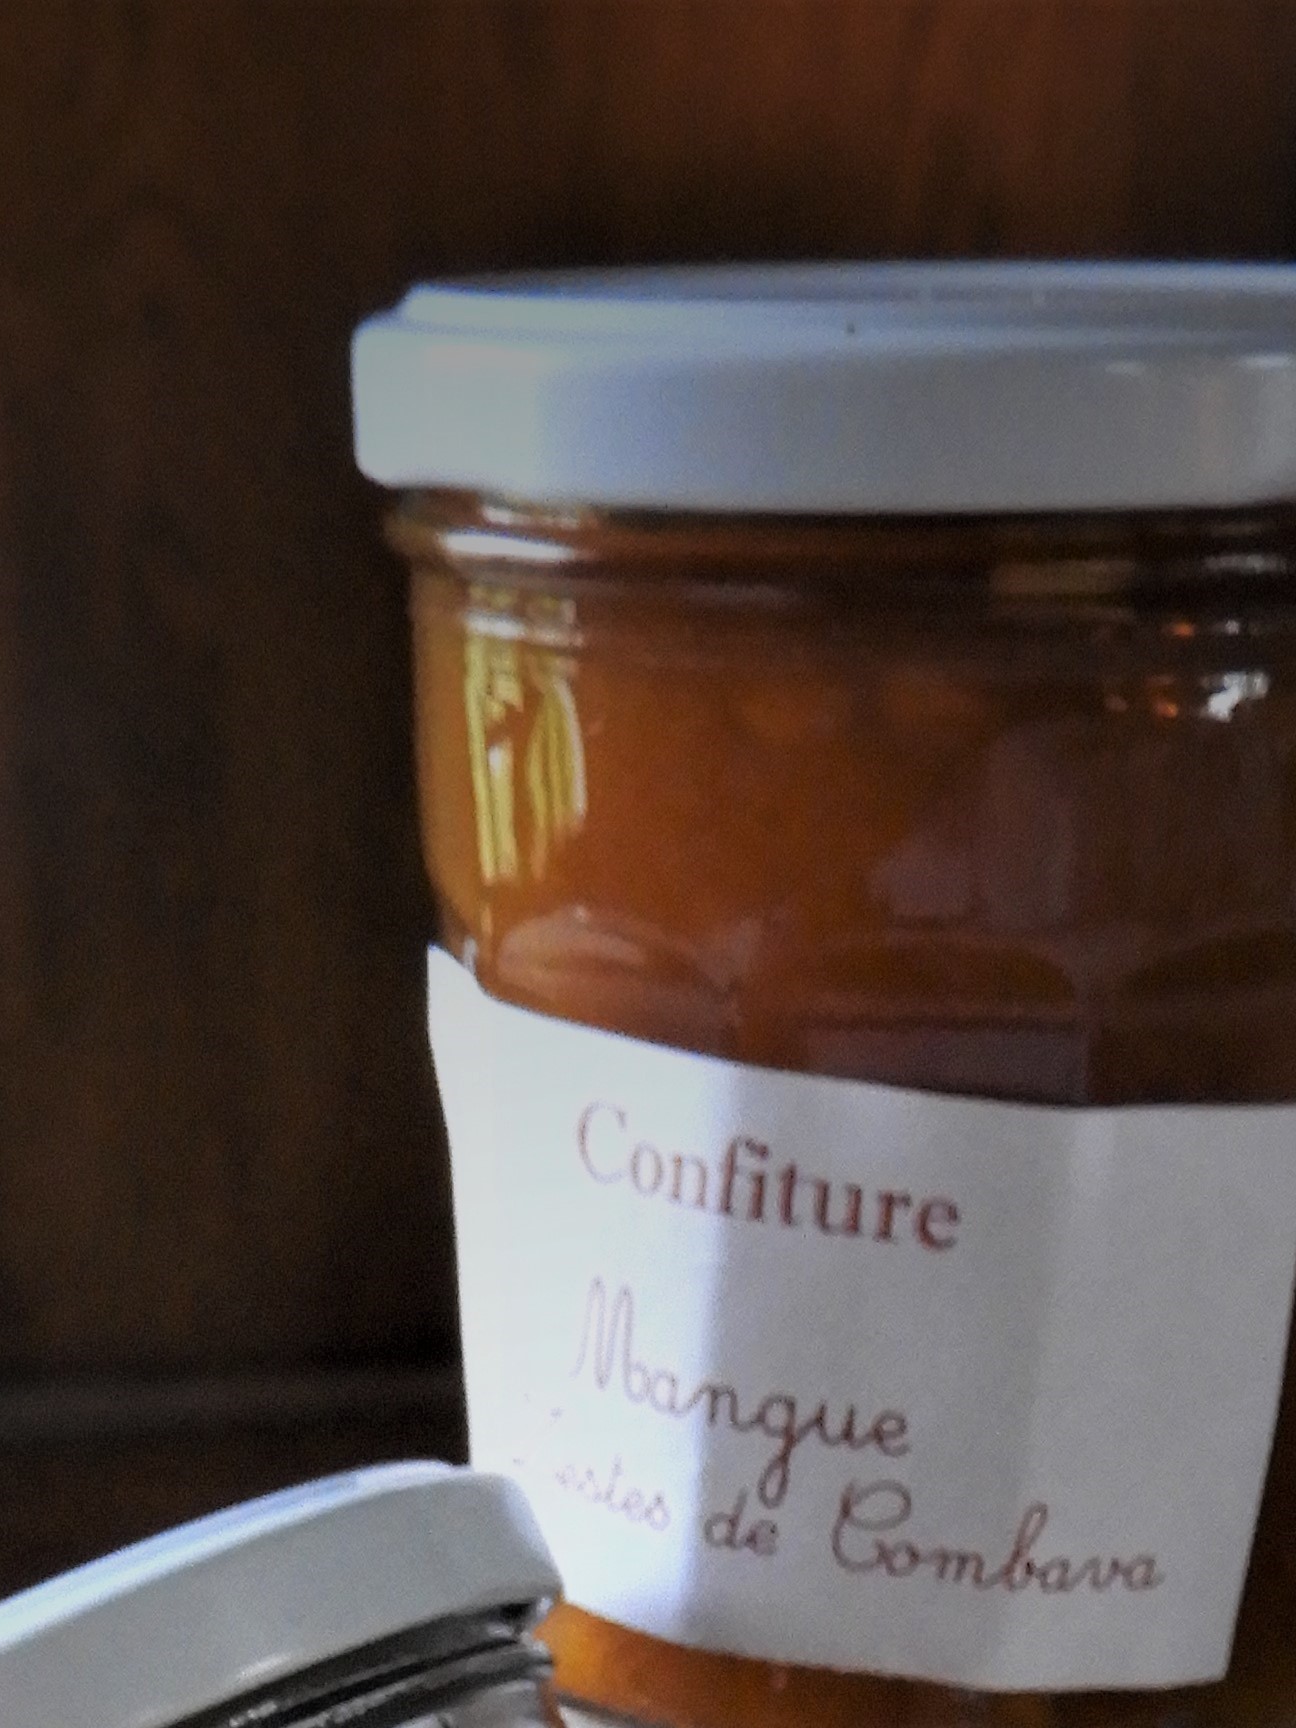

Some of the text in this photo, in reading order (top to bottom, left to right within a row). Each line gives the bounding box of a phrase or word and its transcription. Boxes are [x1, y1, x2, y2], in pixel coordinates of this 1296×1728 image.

[576, 1099, 962, 1252] Confiture
[570, 1276, 911, 1508] Mangue
[705, 1489, 779, 1554] de
[831, 1478, 1164, 1594] Combava
